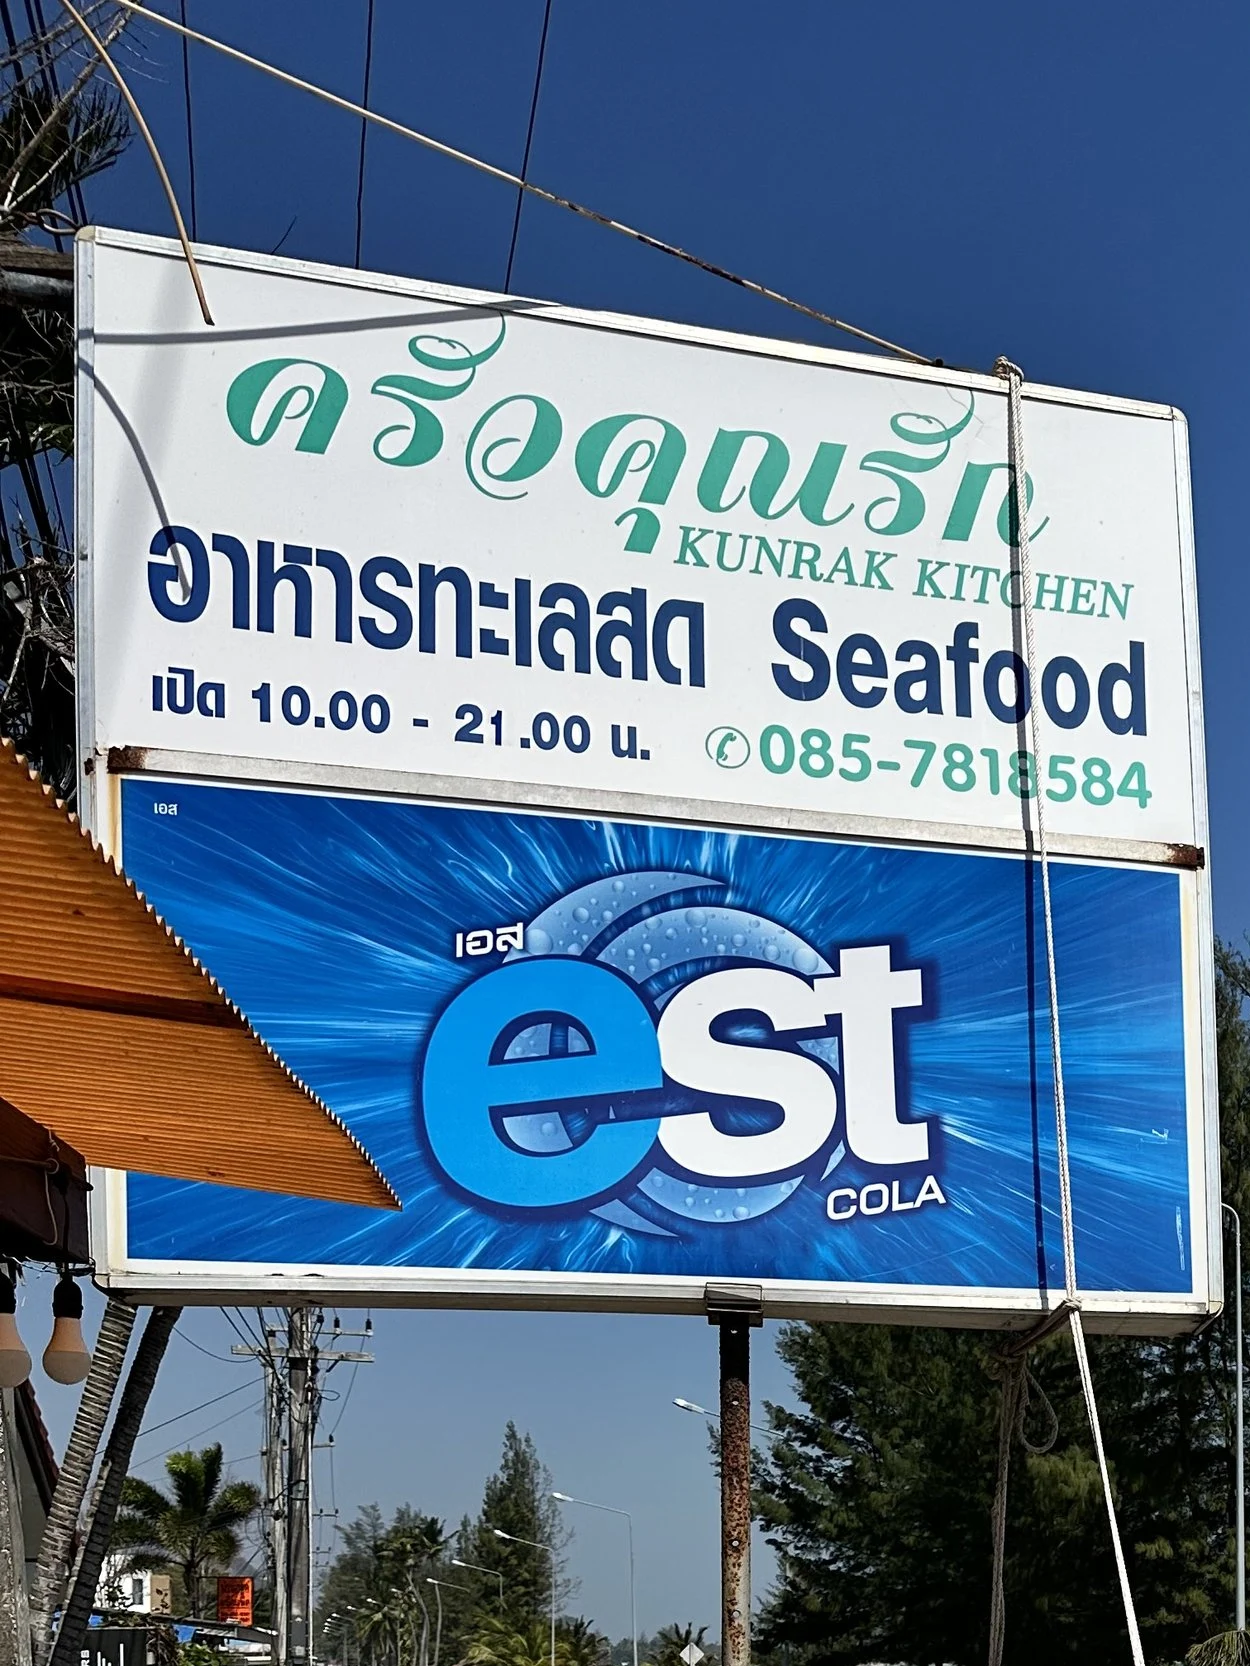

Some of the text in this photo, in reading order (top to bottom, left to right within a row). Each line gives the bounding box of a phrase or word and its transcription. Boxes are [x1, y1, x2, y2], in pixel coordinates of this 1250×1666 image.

[226, 312, 1050, 555] ครัวคุณรัก
[673, 525, 1134, 620] KUNRAK KITCHEN
[147, 525, 1149, 737] อาหารทะเลสด Seafood
[152, 666, 651, 761] เปิด 10.00 - 21.00 น.
[154, 802, 178, 816] เอส
[759, 724, 1153, 809] 085-7818584
[455, 921, 525, 958] เอส
[422, 944, 930, 1208] est
[825, 1174, 947, 1221] COLA
